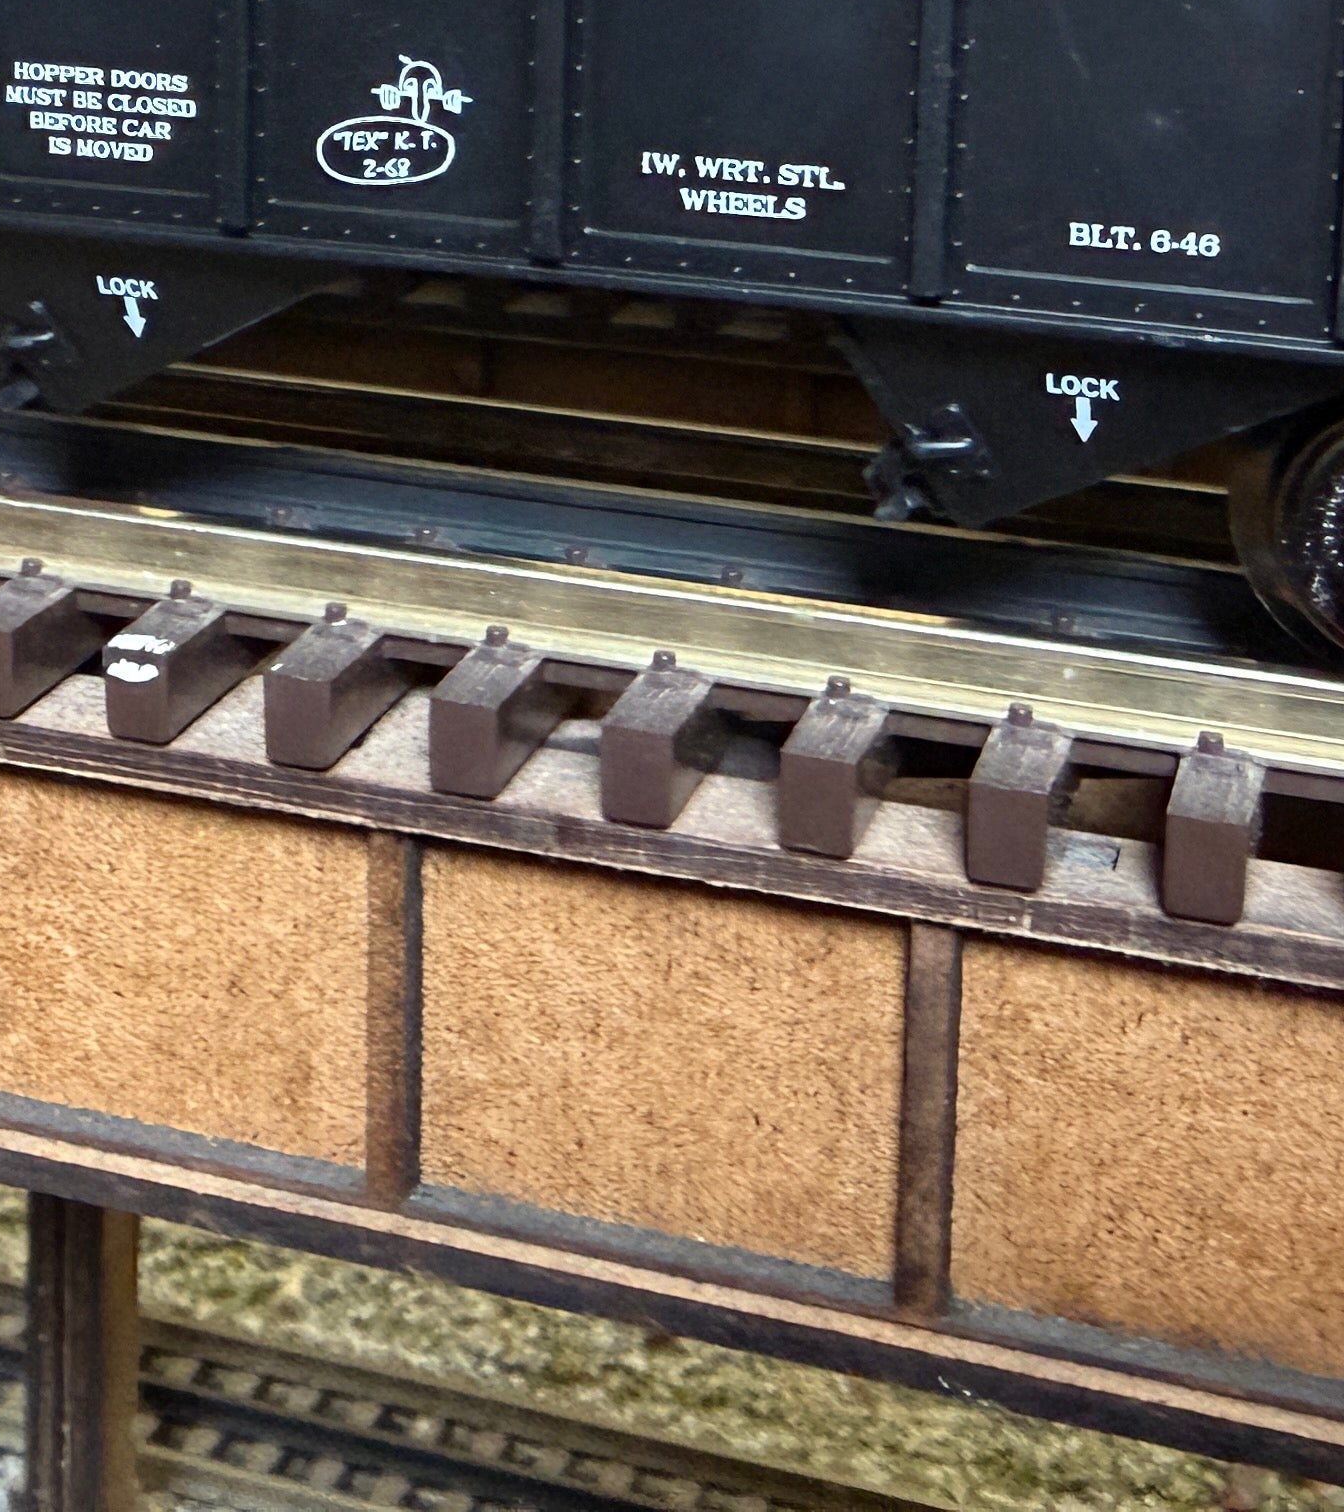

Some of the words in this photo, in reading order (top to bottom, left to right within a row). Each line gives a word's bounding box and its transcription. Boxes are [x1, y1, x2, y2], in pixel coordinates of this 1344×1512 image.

[13, 61, 105, 86] HOPPER
[110, 69, 189, 93] DOORS
[5, 85, 67, 107] MUST
[72, 90, 103, 110] BE
[107, 93, 197, 118] CLOSED
[29, 111, 118, 135] BEFORE
[122, 119, 172, 140] CAR
[48, 136, 72, 155] IS
[76, 138, 154, 162] MOVED
[694, 155, 771, 184] WRT.
[679, 187, 808, 220] WHEELS
[1069, 221, 1142, 251] BLT.
[1150, 229, 1221, 258] 6-46
[96, 275, 159, 301] LOCK
[1045, 372, 1120, 402] LOCK
